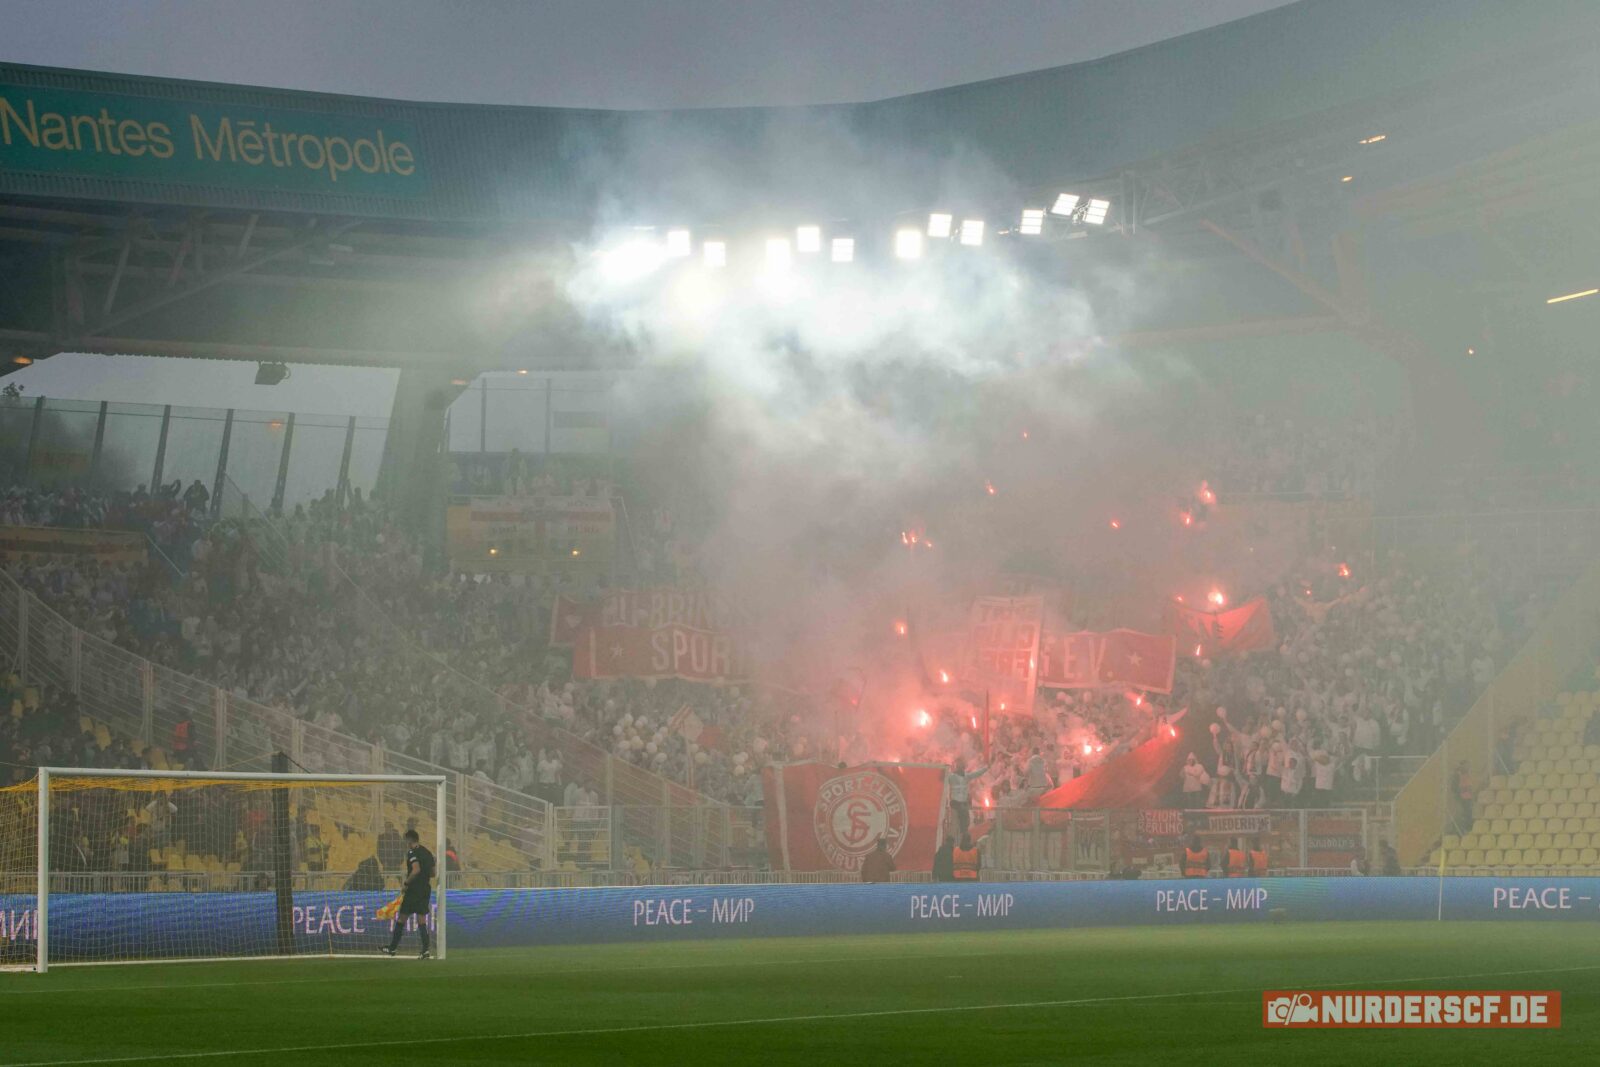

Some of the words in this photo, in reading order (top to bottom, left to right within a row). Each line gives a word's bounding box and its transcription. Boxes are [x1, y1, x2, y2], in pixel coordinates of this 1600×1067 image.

[0, 96, 175, 159] Nantes
[910, 894, 961, 919] PEACE
[1156, 889, 1208, 912] PEACE
[1493, 887, 1572, 909] PEACE
[291, 905, 366, 935] PEACE
[633, 898, 693, 926] PEACE
